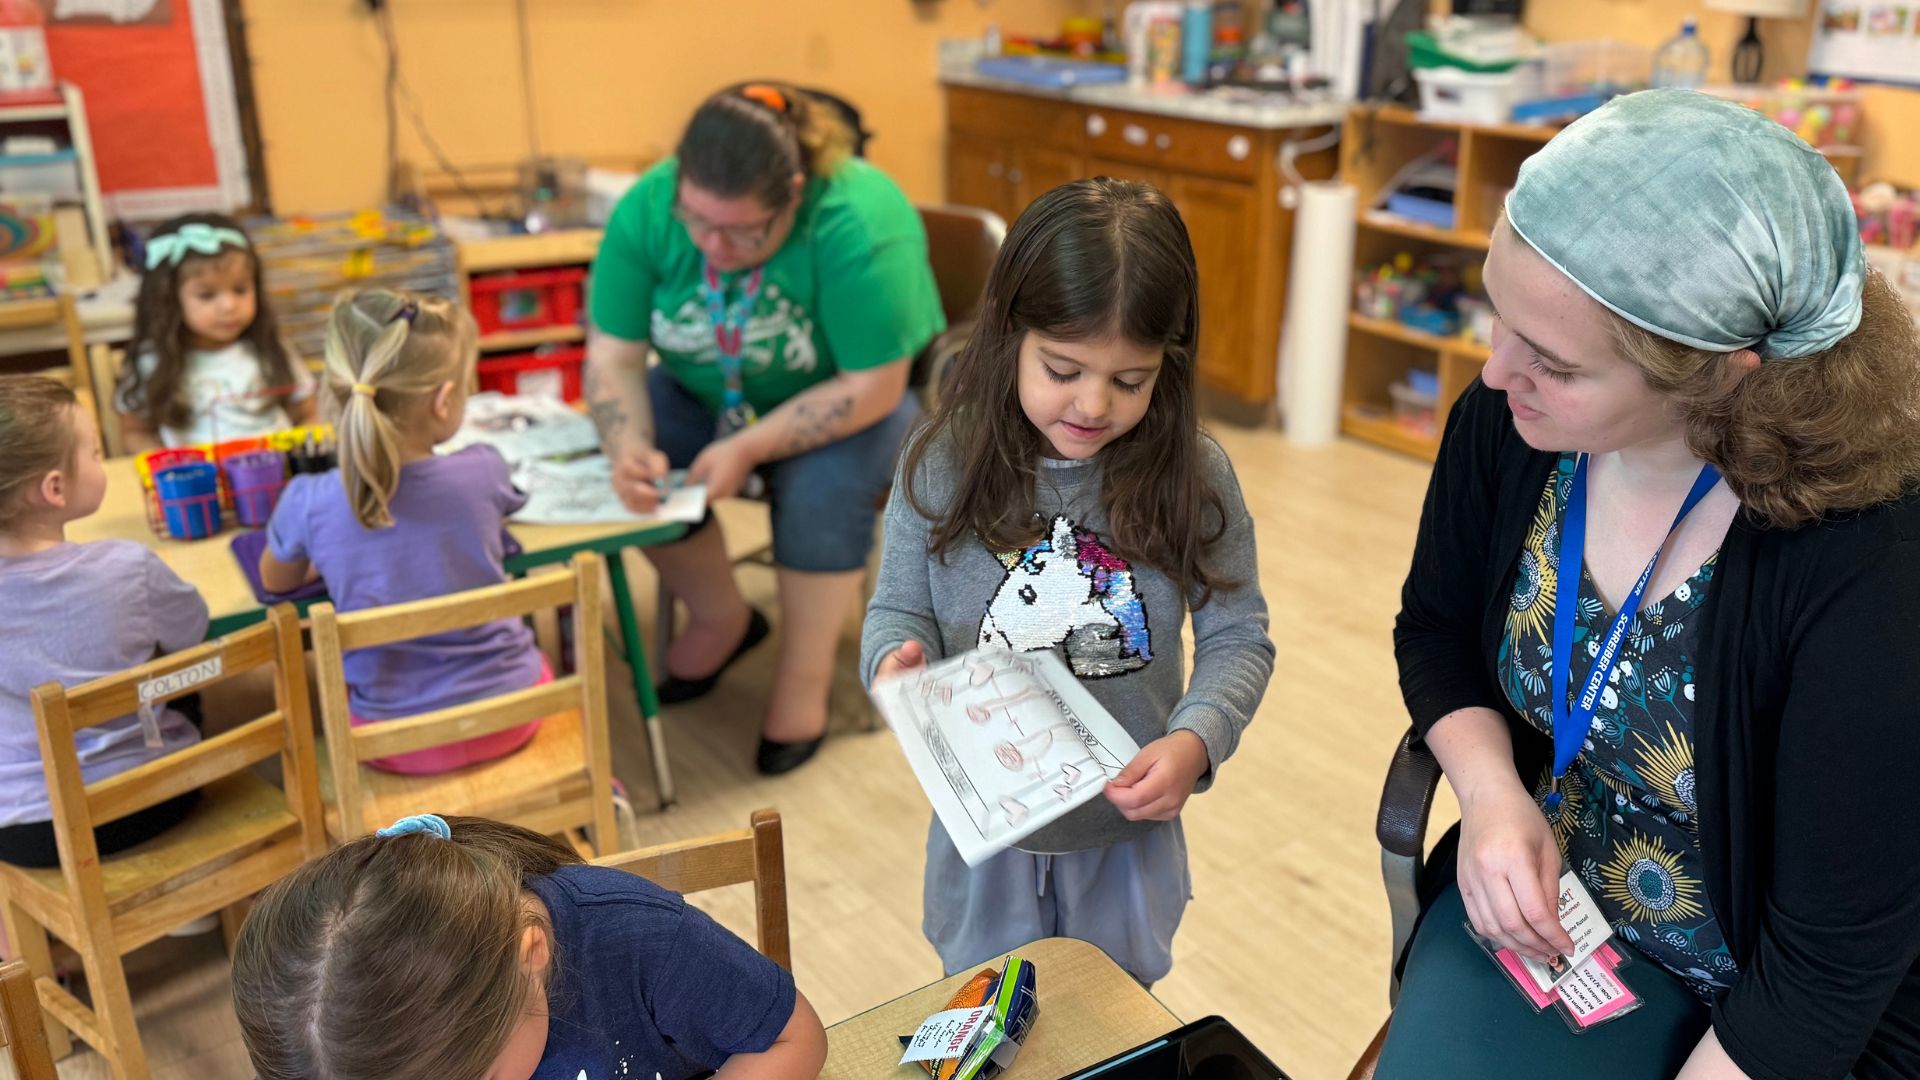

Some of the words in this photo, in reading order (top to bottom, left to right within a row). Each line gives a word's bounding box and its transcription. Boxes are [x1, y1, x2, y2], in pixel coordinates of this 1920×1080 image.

[1598, 613, 1629, 671] SCHREIBER
[140, 660, 217, 700] COLTON
[1580, 671, 1604, 711] CENTER
